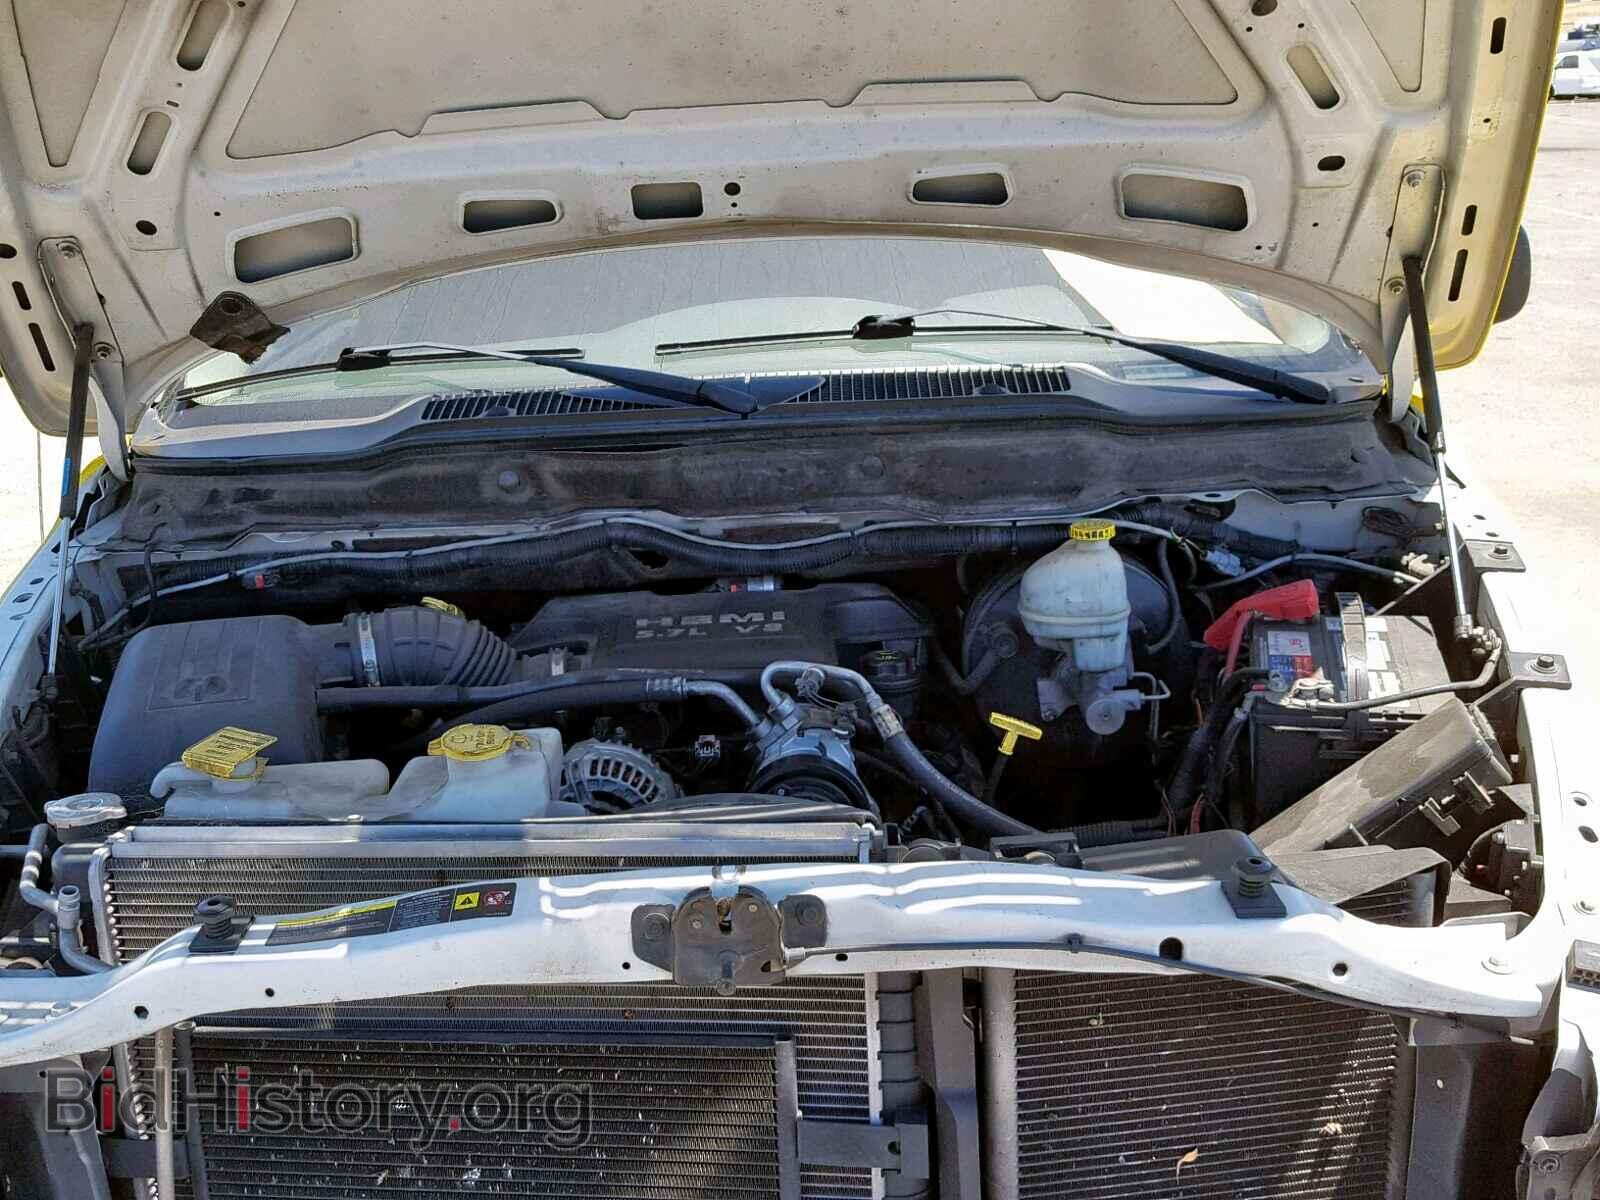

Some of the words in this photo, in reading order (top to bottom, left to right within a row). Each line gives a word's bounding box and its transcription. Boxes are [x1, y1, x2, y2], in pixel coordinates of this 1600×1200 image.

[635, 611, 785, 627] HEMI
[635, 626, 707, 639] 5.7L
[735, 623, 783, 634] V8
